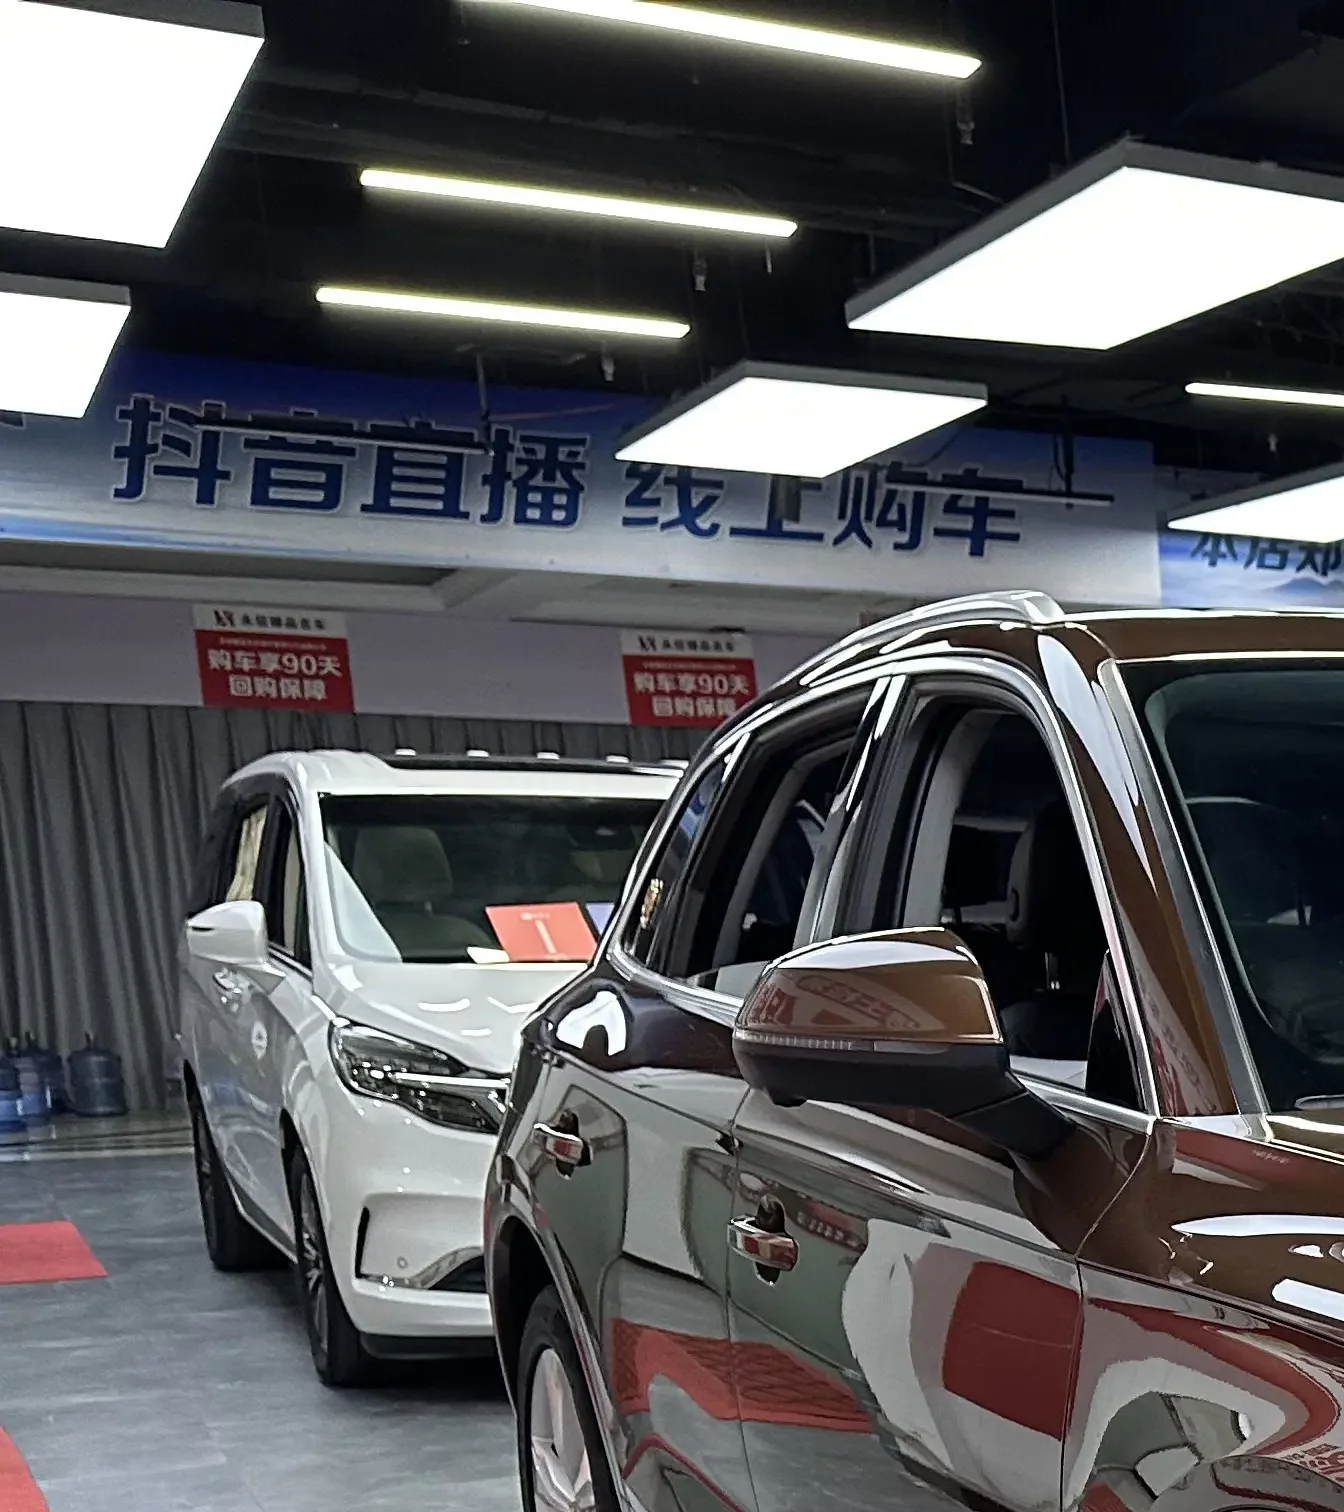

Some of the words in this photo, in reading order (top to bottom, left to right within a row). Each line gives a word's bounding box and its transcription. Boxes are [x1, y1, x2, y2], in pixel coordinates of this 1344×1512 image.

[112, 394, 590, 528] 抖音直播
[621, 461, 1021, 557] 线上购车
[207, 648, 343, 678] 购车享90天
[228, 674, 328, 701] 回购保障
[632, 671, 750, 696] 购车享90天
